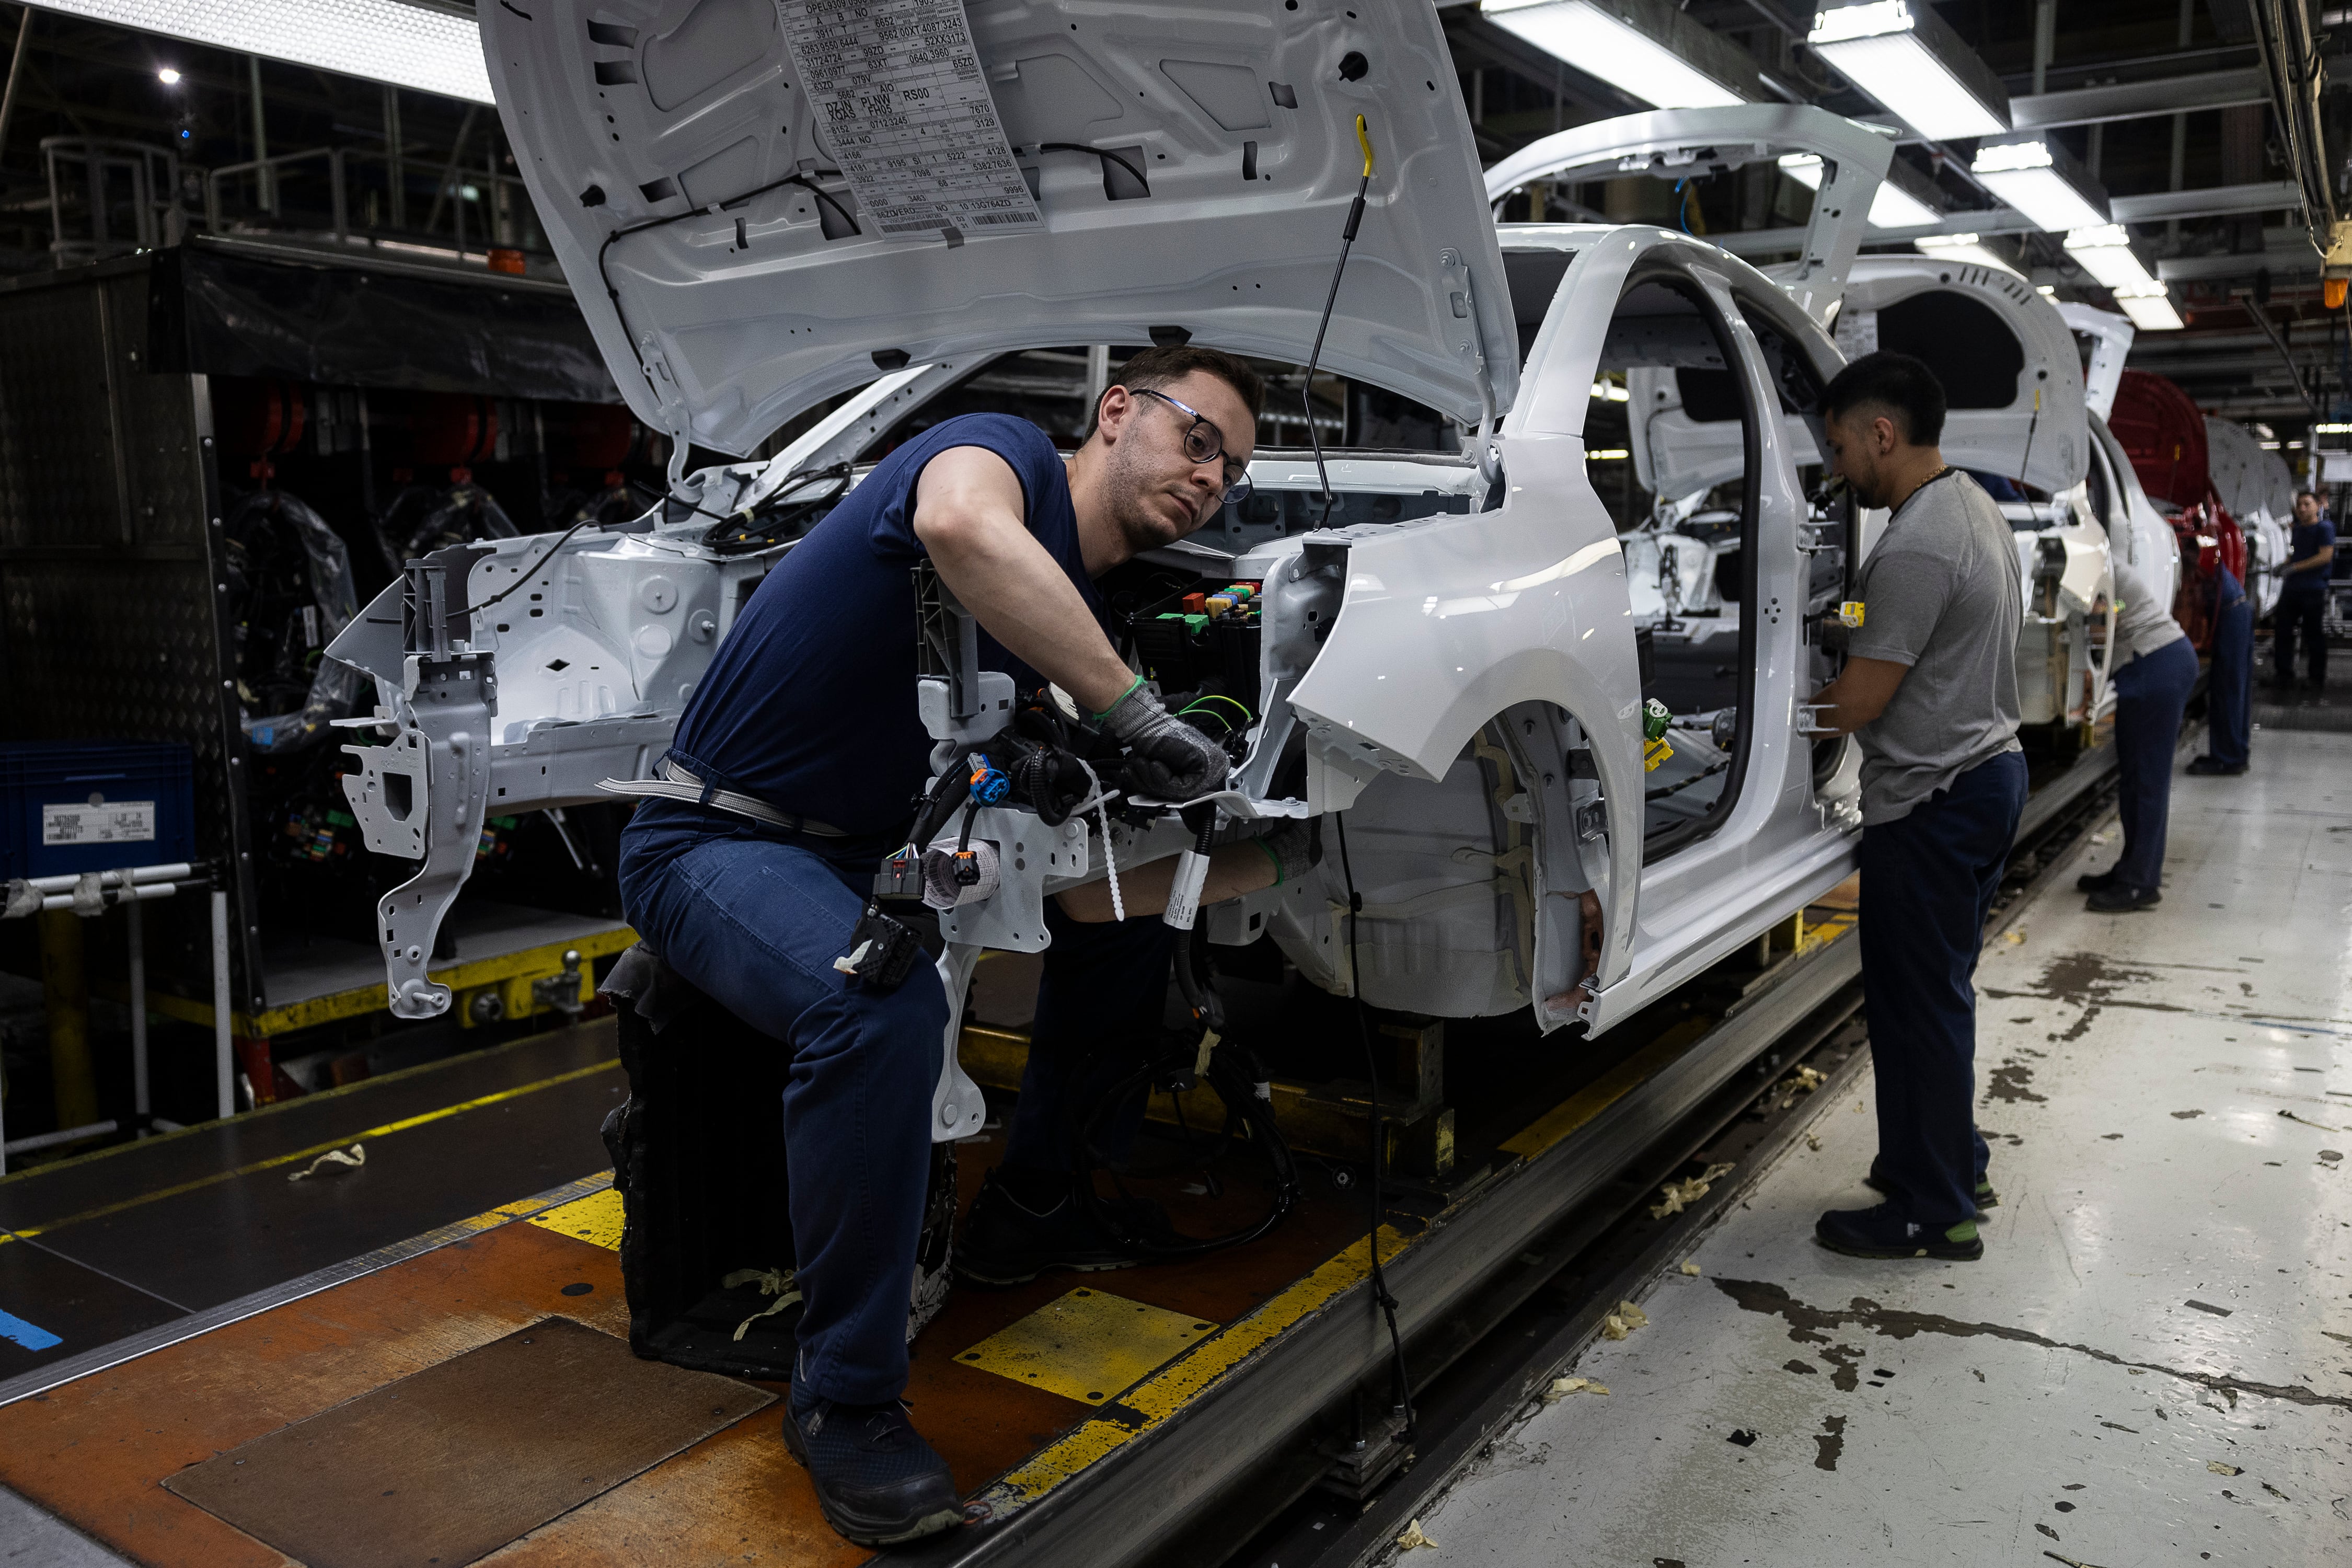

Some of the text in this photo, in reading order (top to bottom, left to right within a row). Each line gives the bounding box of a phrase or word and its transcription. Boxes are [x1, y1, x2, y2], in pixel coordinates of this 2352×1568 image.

[806, 3, 828, 14] OPEL
[817, 17, 823, 26] A
[837, 13, 844, 21] B
[855, 8, 868, 18] NO
[801, 44, 820, 55] 6263
[820, 41, 838, 51] 9550
[840, 37, 858, 48] 6444
[879, 30, 898, 40] 9562
[922, 22, 941, 33] 4087
[942, 18, 962, 29] 3243
[815, 28, 834, 39] 3911
[841, 25, 847, 33] T
[875, 17, 894, 28] 6652
[806, 56, 823, 67] 3172
[825, 53, 842, 64] 4724
[863, 46, 884, 57] 99ZD
[925, 35, 946, 46] 52XX
[945, 32, 966, 43] 3173
[811, 70, 828, 79] 0961
[828, 66, 845, 76] 0977
[868, 59, 888, 69] 63XT
[909, 52, 928, 63] 0640
[930, 48, 949, 59] 3960
[814, 81, 833, 91] 63ZD
[953, 57, 974, 68] 65ZD
[826, 100, 852, 113] DZJN
[860, 94, 891, 108] PLNW
[838, 90, 856, 100] 5662
[828, 110, 856, 121] XQAS
[970, 105, 989, 114] 7670
[831, 125, 849, 134] 8152
[870, 119, 888, 129] 0712
[889, 117, 907, 126] 3245
[975, 118, 995, 128] 3129
[837, 137, 855, 147] 3444
[858, 136, 871, 144] NO
[844, 151, 862, 160] 4166
[850, 164, 867, 172] 4181
[888, 159, 906, 168] 9195
[947, 152, 966, 160] 5222
[987, 146, 1006, 156] 4128
[857, 159, 1012, 183] 3922 7098 5382 7636
[1005, 185, 1024, 194] 9996
